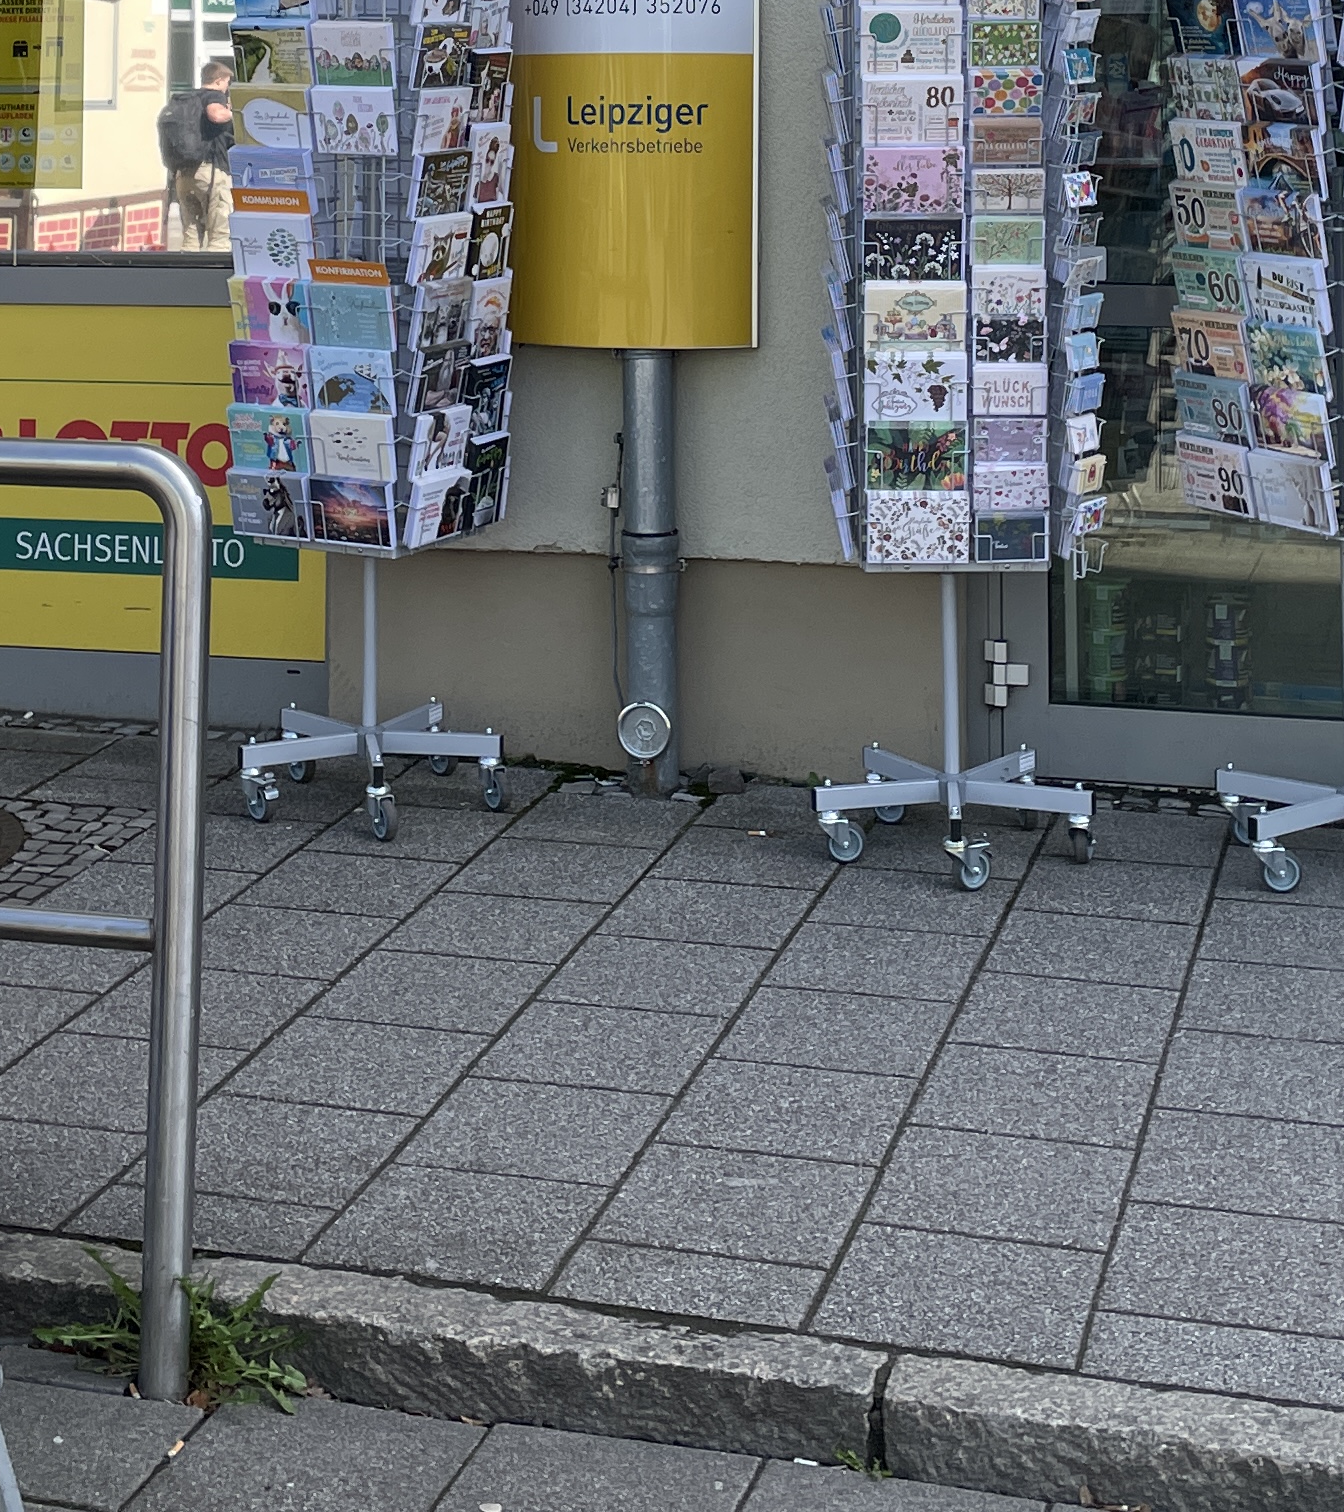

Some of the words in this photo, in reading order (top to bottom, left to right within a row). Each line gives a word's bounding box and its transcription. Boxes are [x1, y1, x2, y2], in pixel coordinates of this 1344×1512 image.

[926, 86, 954, 108] 80
[567, 96, 709, 134] Leipziger
[567, 137, 703, 154] Verkehrsbetriebe
[242, 194, 299, 206] KOMMUNION
[1175, 195, 1206, 229] 50
[315, 266, 382, 278] KONFIRMATION
[1272, 271, 1283, 284] DU
[1208, 271, 1240, 304] 60
[1178, 327, 1210, 361] 70
[984, 378, 1030, 393] GLÜCK
[981, 394, 1032, 408] WUNSCH
[1212, 398, 1242, 431] 80
[1218, 467, 1244, 495] 90
